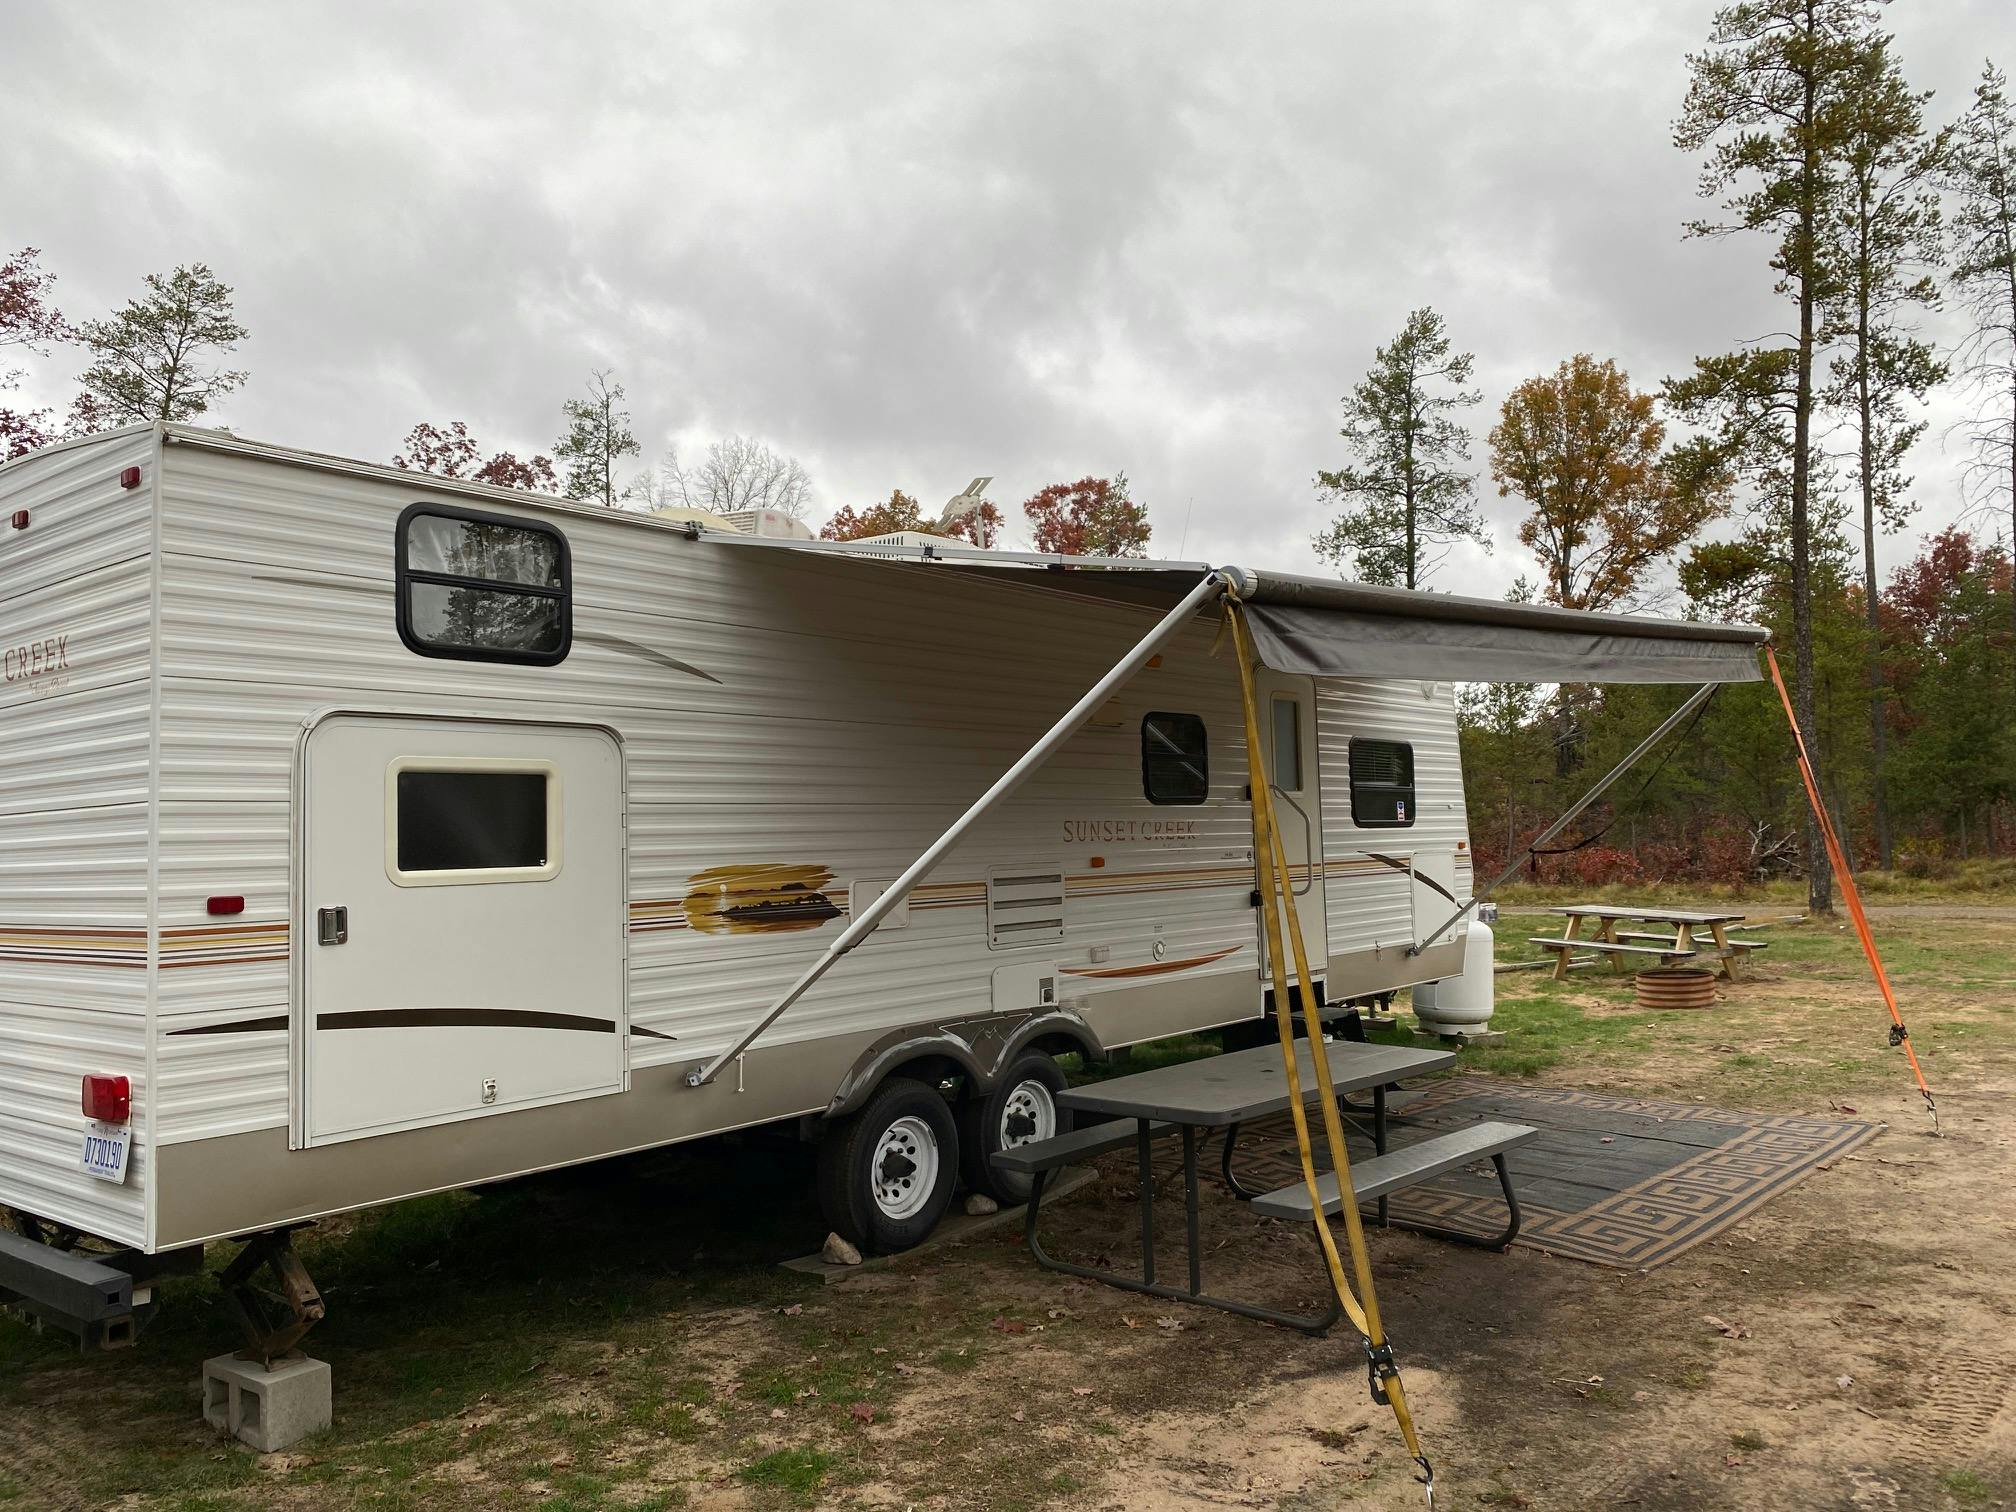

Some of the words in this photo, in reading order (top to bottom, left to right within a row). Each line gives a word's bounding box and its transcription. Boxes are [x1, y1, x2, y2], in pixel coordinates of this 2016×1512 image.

[5, 635, 69, 681] CREEK
[1063, 820, 1137, 842] SUNSET
[1141, 820, 1197, 840] CREEK
